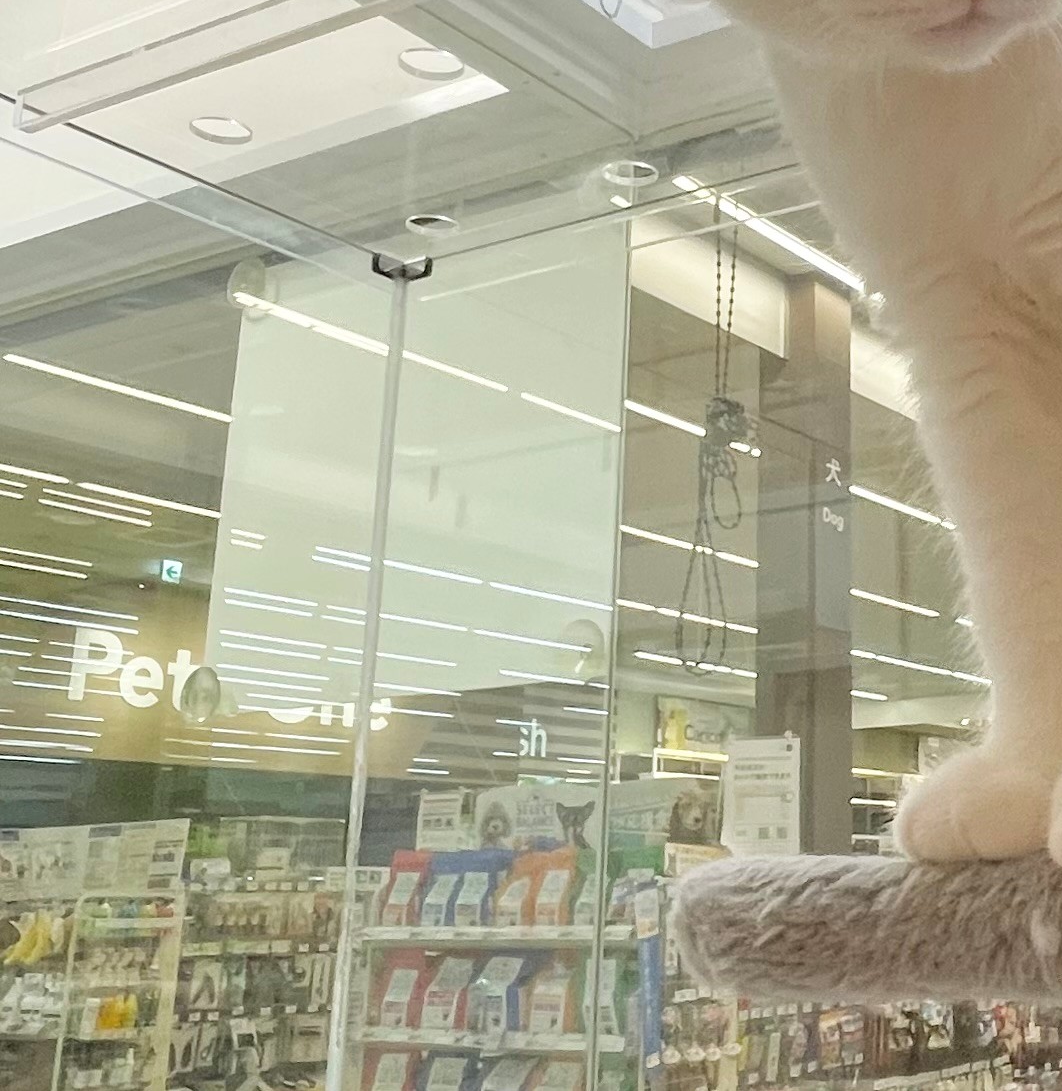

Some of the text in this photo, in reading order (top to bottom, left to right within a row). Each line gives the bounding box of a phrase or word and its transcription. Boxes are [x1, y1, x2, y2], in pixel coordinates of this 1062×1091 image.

[825, 458, 841, 487] 犬
[823, 507, 844, 532] Dog
[68, 627, 203, 712] Pet
